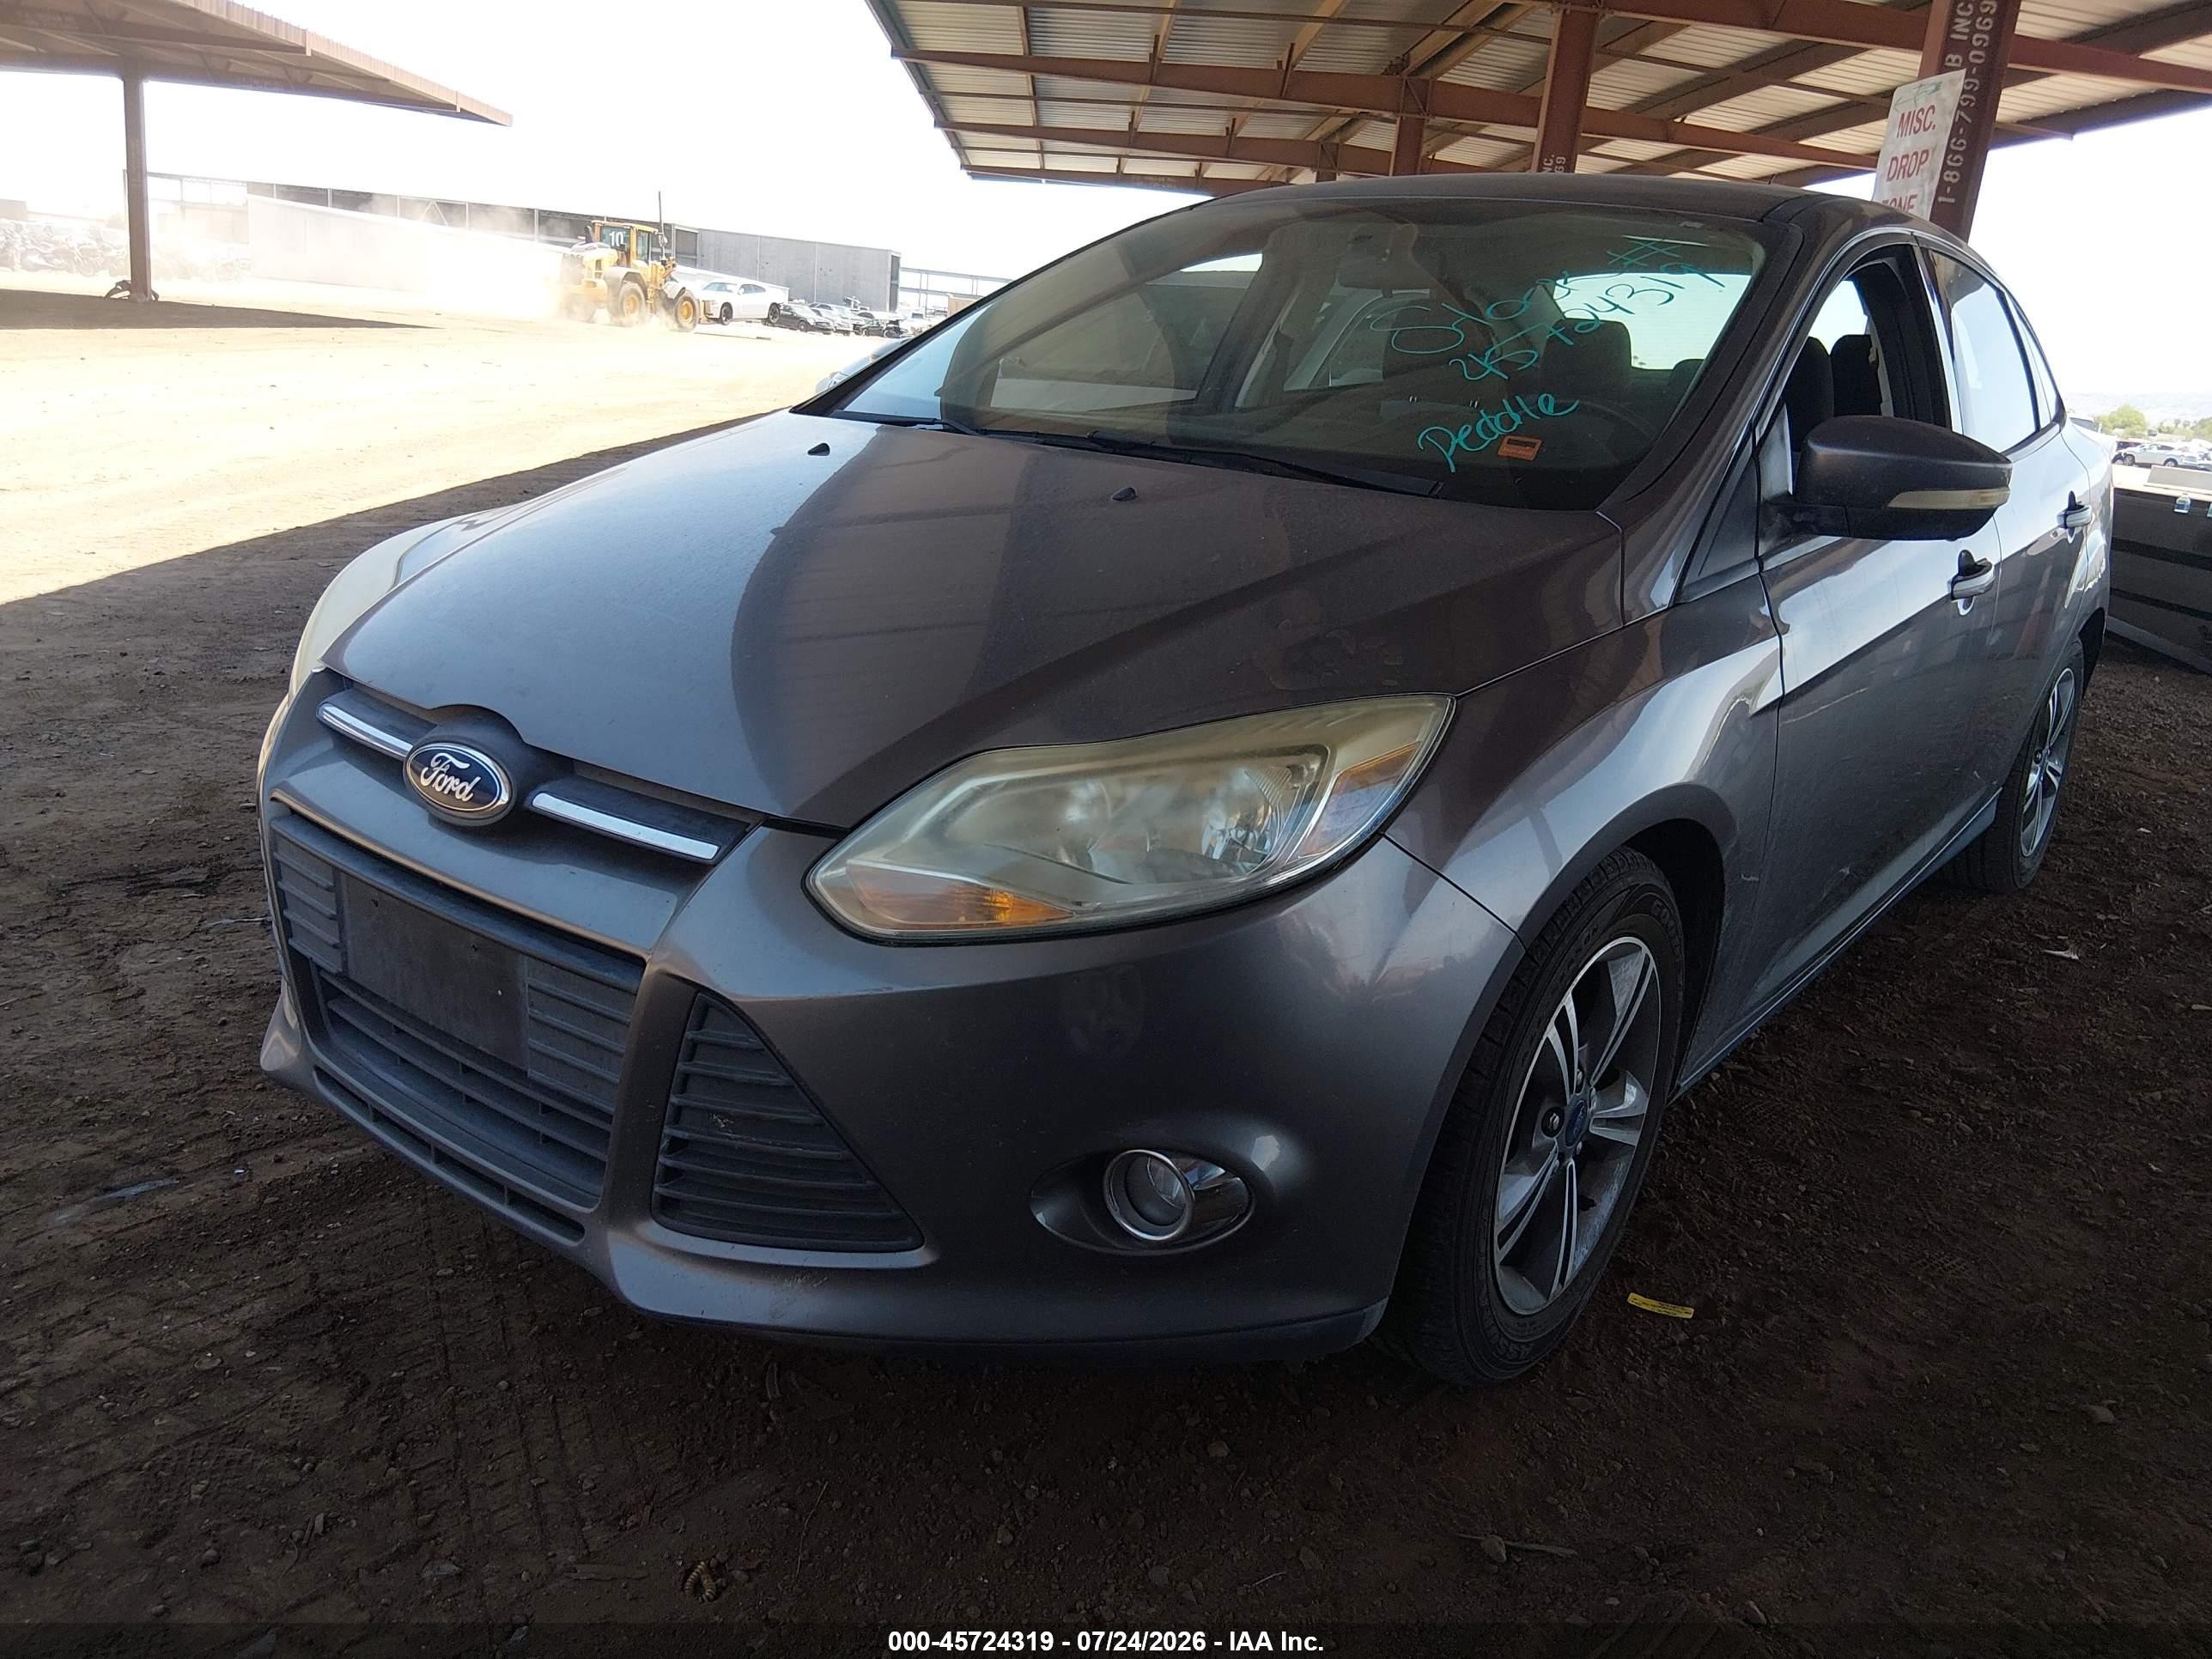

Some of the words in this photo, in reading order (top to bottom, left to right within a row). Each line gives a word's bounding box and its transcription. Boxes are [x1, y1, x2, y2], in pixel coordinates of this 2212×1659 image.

[1950, 0, 1975, 40] INC
[1937, 0, 1998, 204] 1-866-799-0969
[1895, 104, 1936, 138] MISC.
[1886, 149, 1929, 183] DROP
[1881, 193, 1919, 214] NE
[420, 752, 482, 802] Ford
